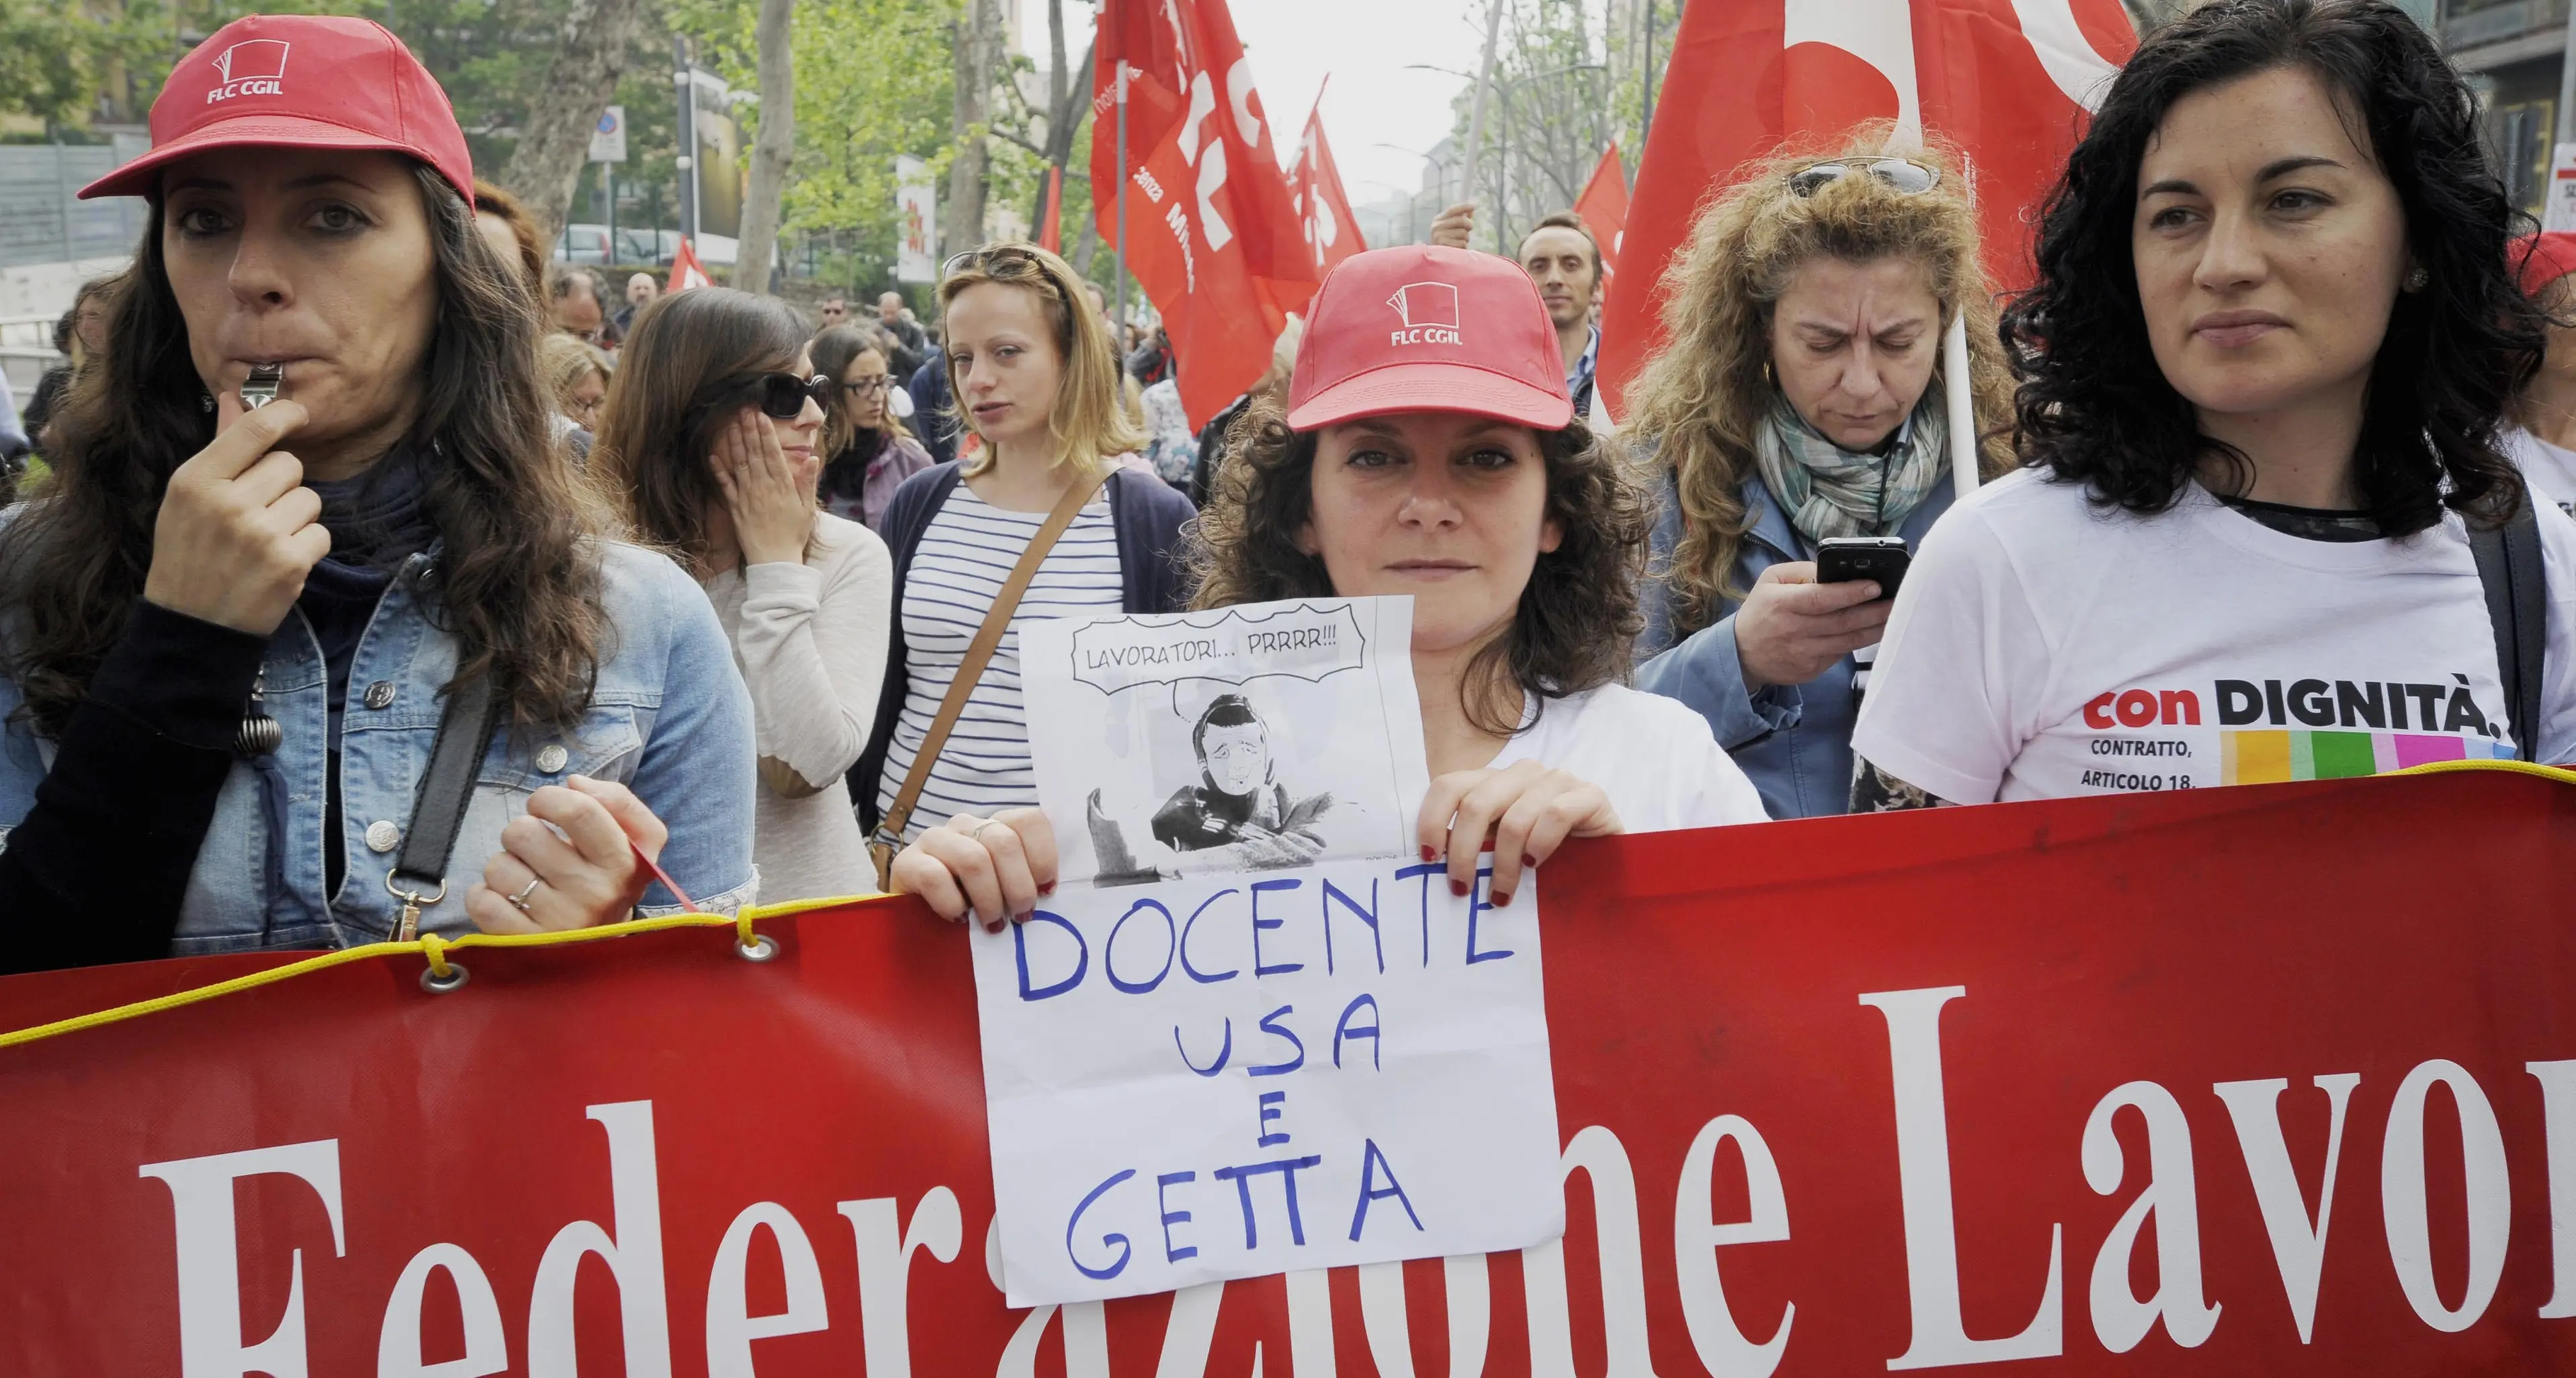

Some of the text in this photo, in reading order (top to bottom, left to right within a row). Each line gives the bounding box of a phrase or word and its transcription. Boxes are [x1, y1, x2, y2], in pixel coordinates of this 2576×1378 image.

[207, 81, 282, 104] FLC CGIL
[1391, 328, 1462, 346] FLC CGIL
[1248, 624, 1337, 655] PRRRR!!!
[2083, 672, 2502, 739] con DIGNITÀ.
[2091, 739, 2192, 759] CONTRATTO,
[2081, 770, 2163, 792] ARTICOLO
[1012, 863, 1515, 1002] DOCENTE
[1174, 993, 1381, 1077] USA
[1257, 1091, 1291, 1148] E
[1066, 1138, 1425, 1281] GETTA
